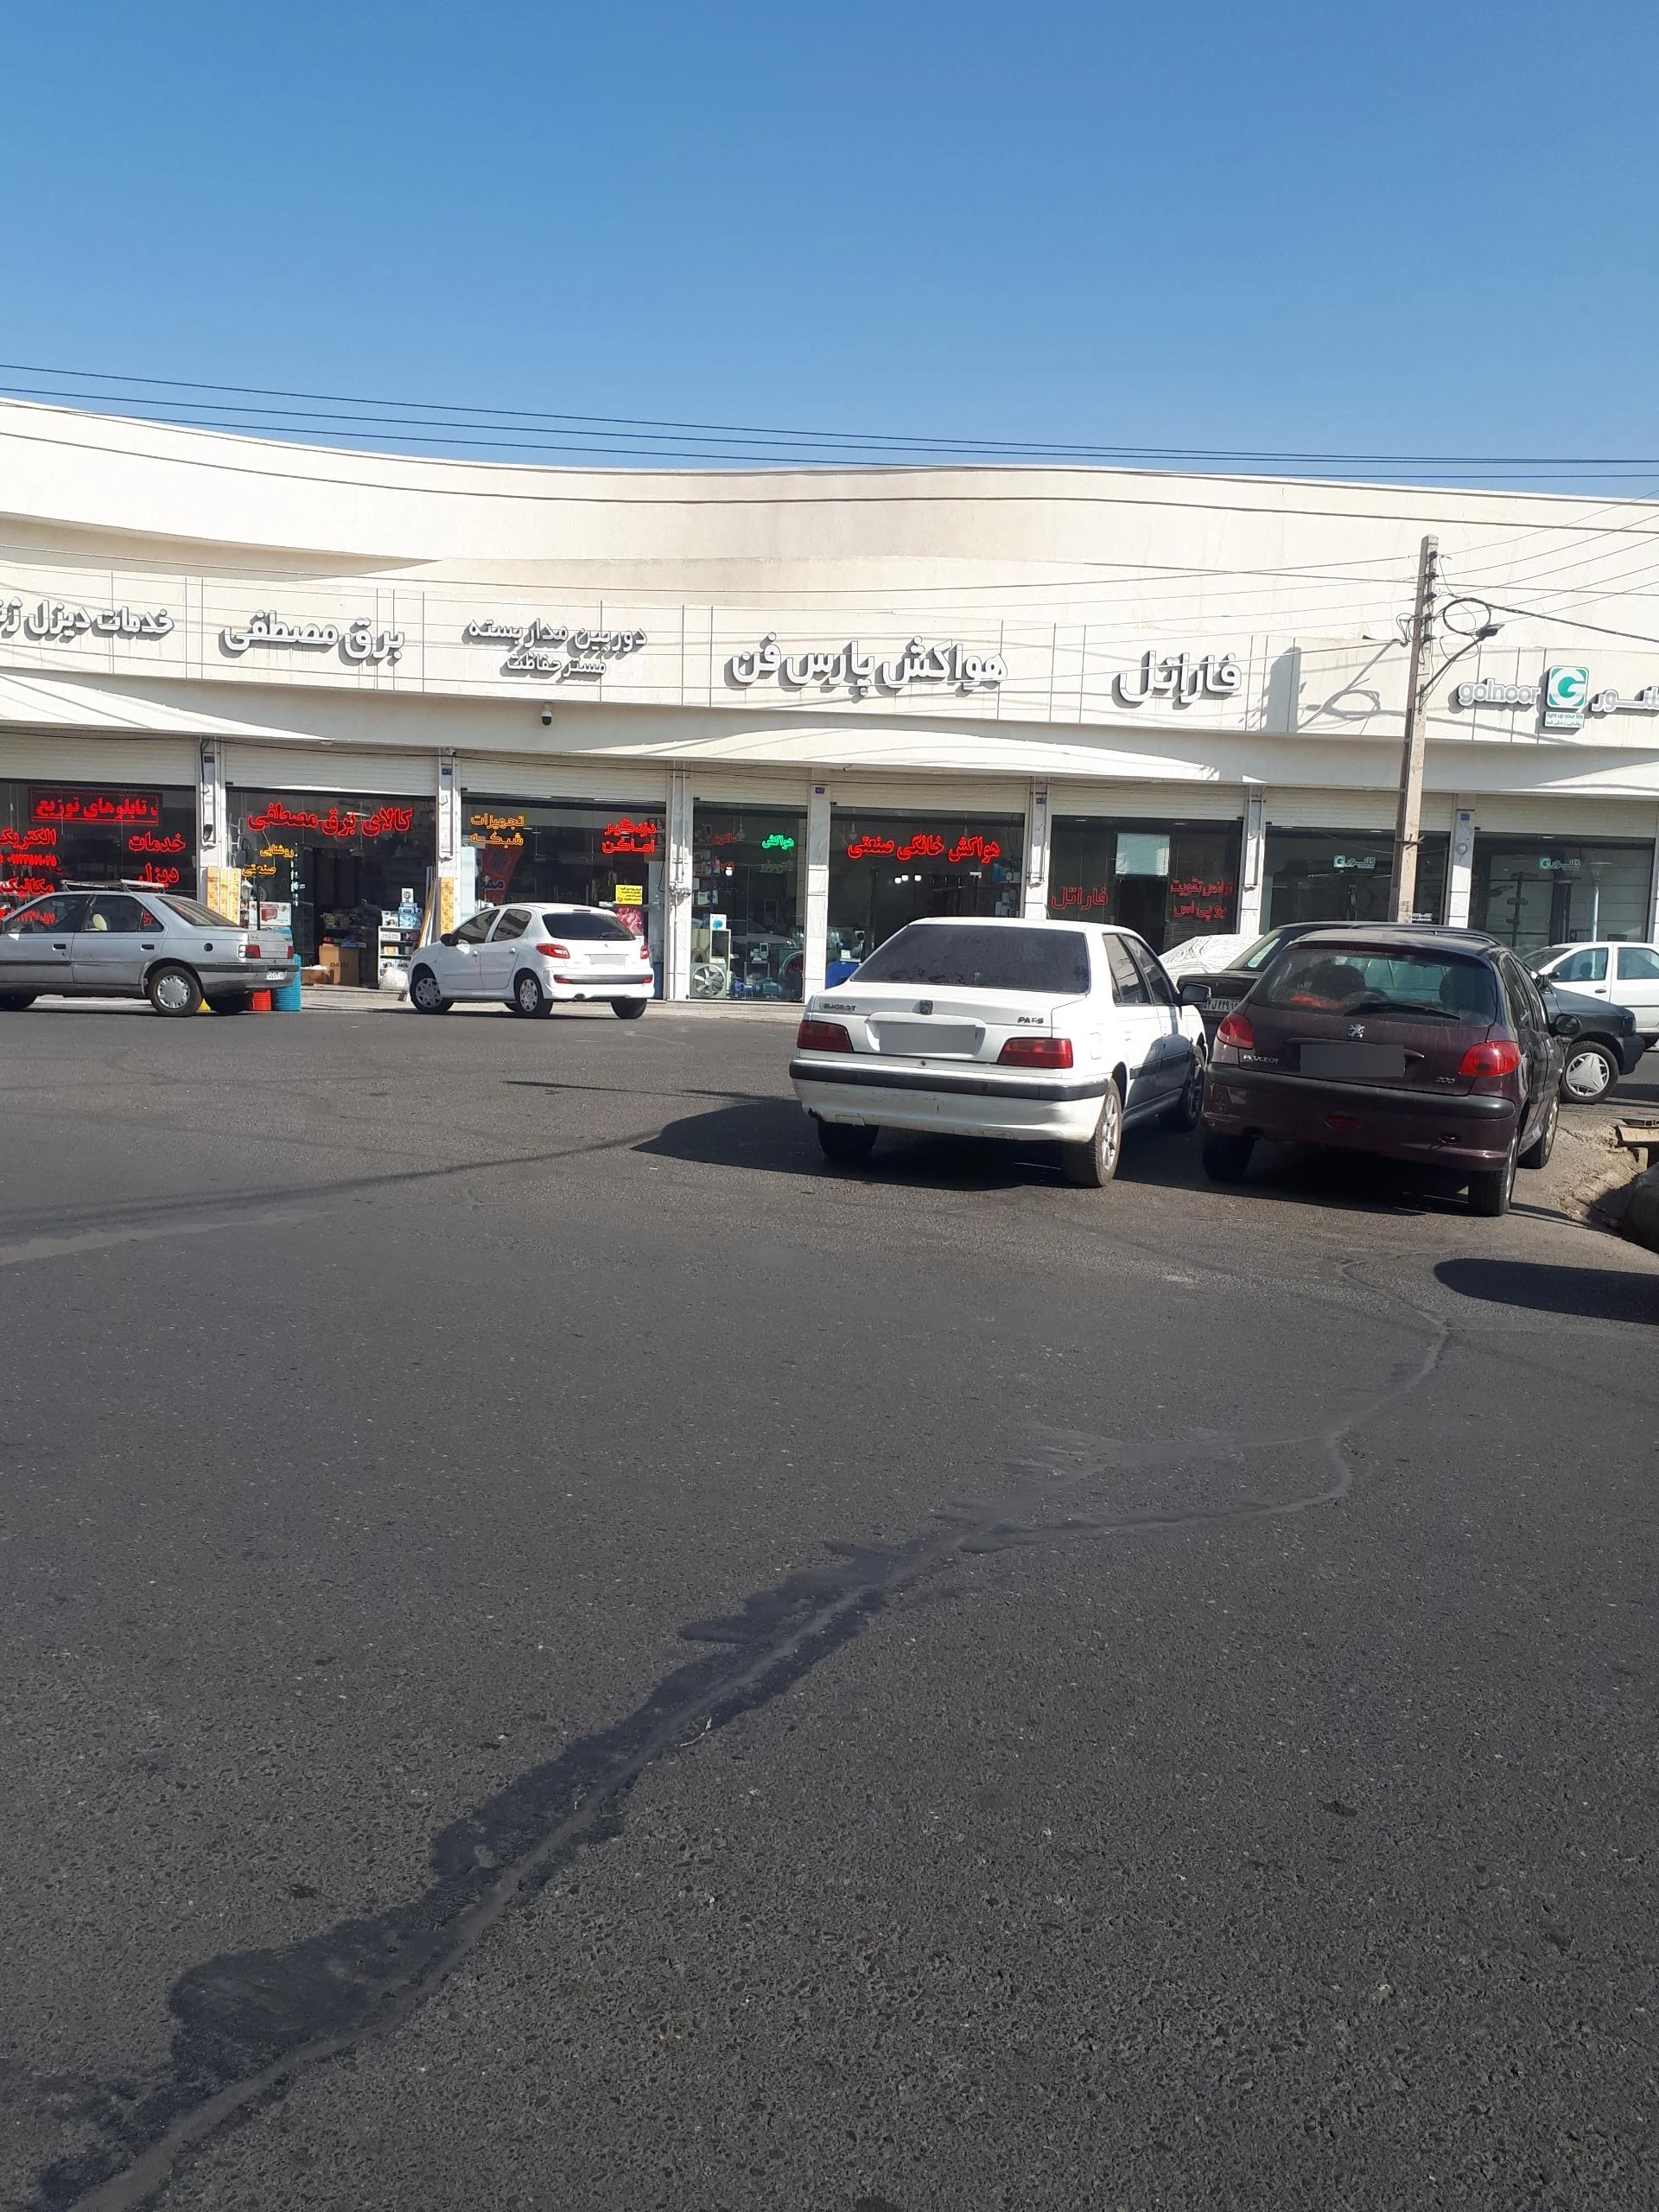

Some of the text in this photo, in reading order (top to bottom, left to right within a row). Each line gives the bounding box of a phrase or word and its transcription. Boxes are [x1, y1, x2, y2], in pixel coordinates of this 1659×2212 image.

[29, 600, 92, 638] دیزل
[96, 606, 175, 636] خدمات
[224, 610, 405, 660] برق مصطفی
[574, 626, 648, 653] دوربین
[506, 652, 607, 677] مستر حفاظت
[732, 632, 1008, 697] هواکش پارس فن
[1119, 650, 1243, 703] فاراتل
[1457, 678, 1541, 707] golnoor
[36, 796, 80, 817] توزیع
[247, 802, 414, 837] کالای برق مصطفی
[469, 813, 525, 828] تجهیزات
[604, 818, 658, 838] دزدگیر
[0, 828, 58, 850] الکتریک
[128, 830, 187, 854] خدمات
[259, 843, 296, 858] روشنایی
[469, 830, 524, 849] شبکه
[601, 838, 656, 855] اماکن
[761, 833, 795, 851] هواکش
[847, 833, 1001, 863] هواکش خانگی صنعتی
[0, 876, 55, 899] مکانیک
[1051, 886, 1109, 911] فاراتل
[1173, 899, 1195, 918] اس
[1196, 905, 1212, 922] پی
[818, 1002, 857, 1011] PEUGEOT
[1243, 1053, 1281, 1064] PEUGEOT
